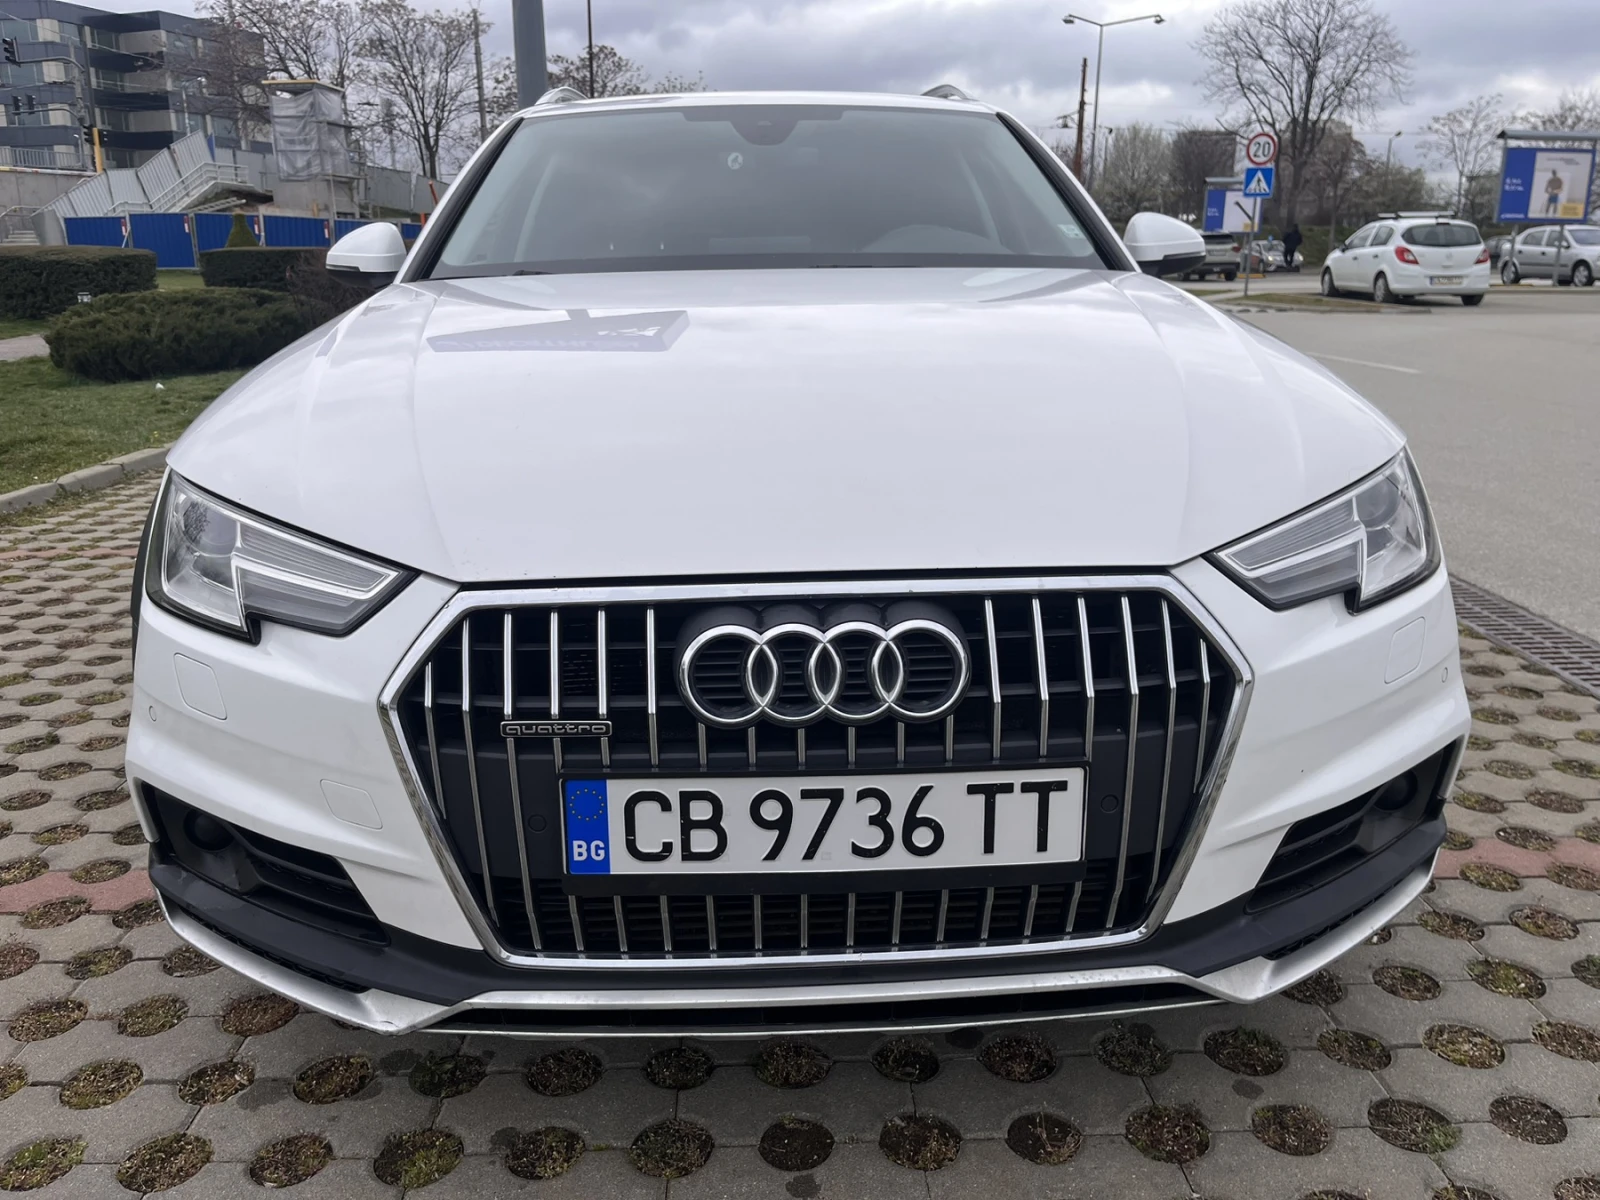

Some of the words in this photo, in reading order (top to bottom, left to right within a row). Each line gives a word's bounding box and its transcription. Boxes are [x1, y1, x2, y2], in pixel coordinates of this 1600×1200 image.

[1253, 141, 1271, 158] 20
[506, 724, 606, 735] quattro
[624, 790, 728, 862] CB
[750, 786, 945, 862] 9736
[967, 780, 1069, 855] TT
[573, 840, 605, 861] BG
